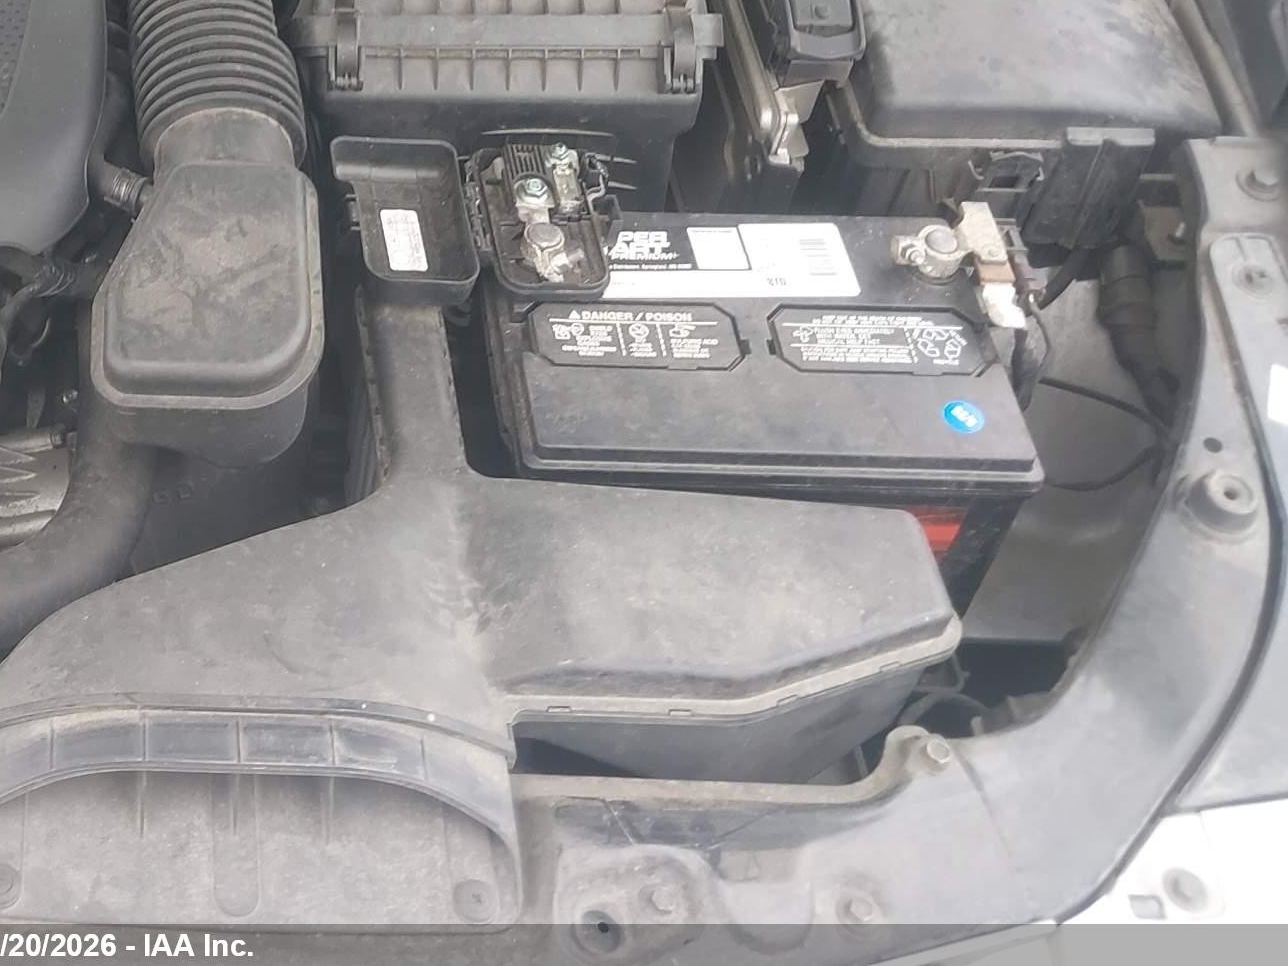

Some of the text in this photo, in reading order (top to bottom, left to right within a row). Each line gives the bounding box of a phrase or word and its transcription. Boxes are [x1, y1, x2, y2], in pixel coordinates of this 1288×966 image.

[617, 230, 668, 243] PER
[582, 311, 633, 321] DANGER
[645, 313, 693, 322] POISON
